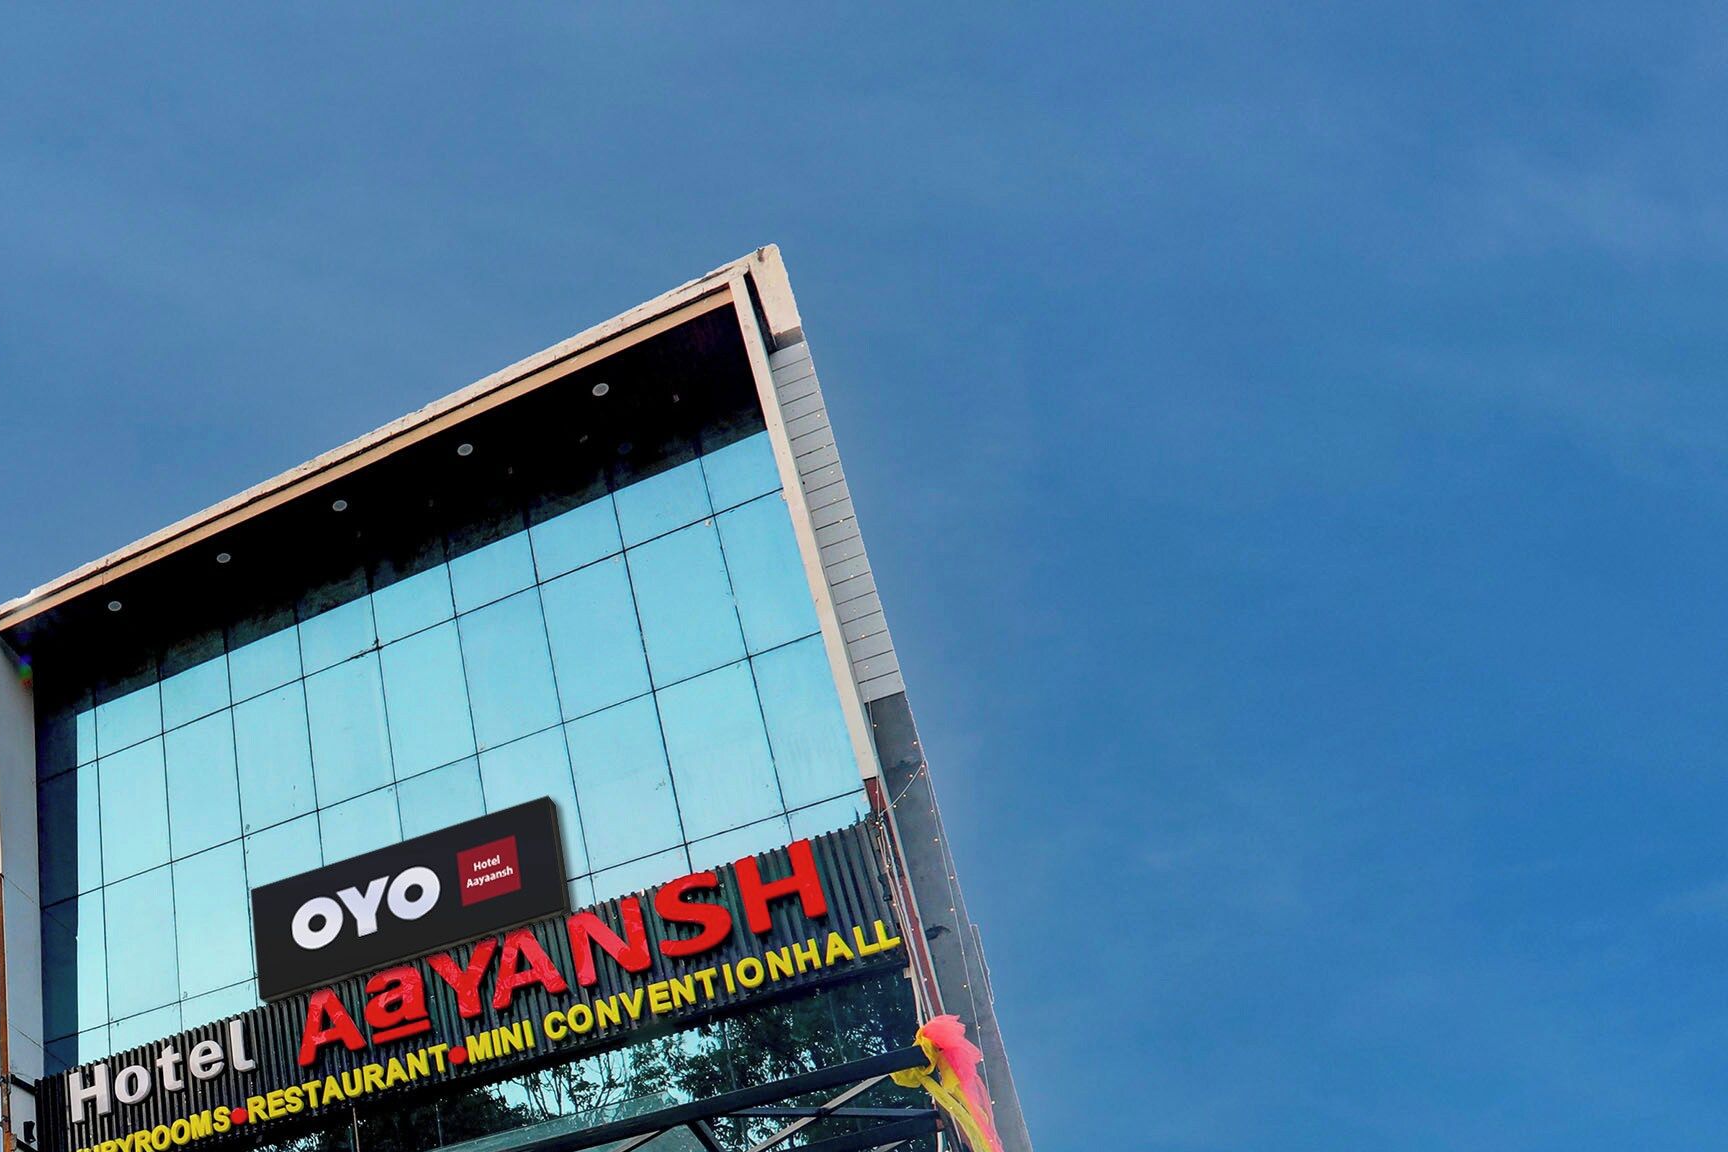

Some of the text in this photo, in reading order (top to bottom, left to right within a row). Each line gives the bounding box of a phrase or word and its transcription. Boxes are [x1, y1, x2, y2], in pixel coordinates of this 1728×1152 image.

[466, 865, 514, 889] Aayaansh
[473, 854, 501, 872] Hotel
[292, 866, 441, 949] OYO
[69, 838, 828, 1124] Hotel AaYANSH
[248, 1043, 449, 1123] RESTAURANT
[467, 1019, 536, 1064] MINI
